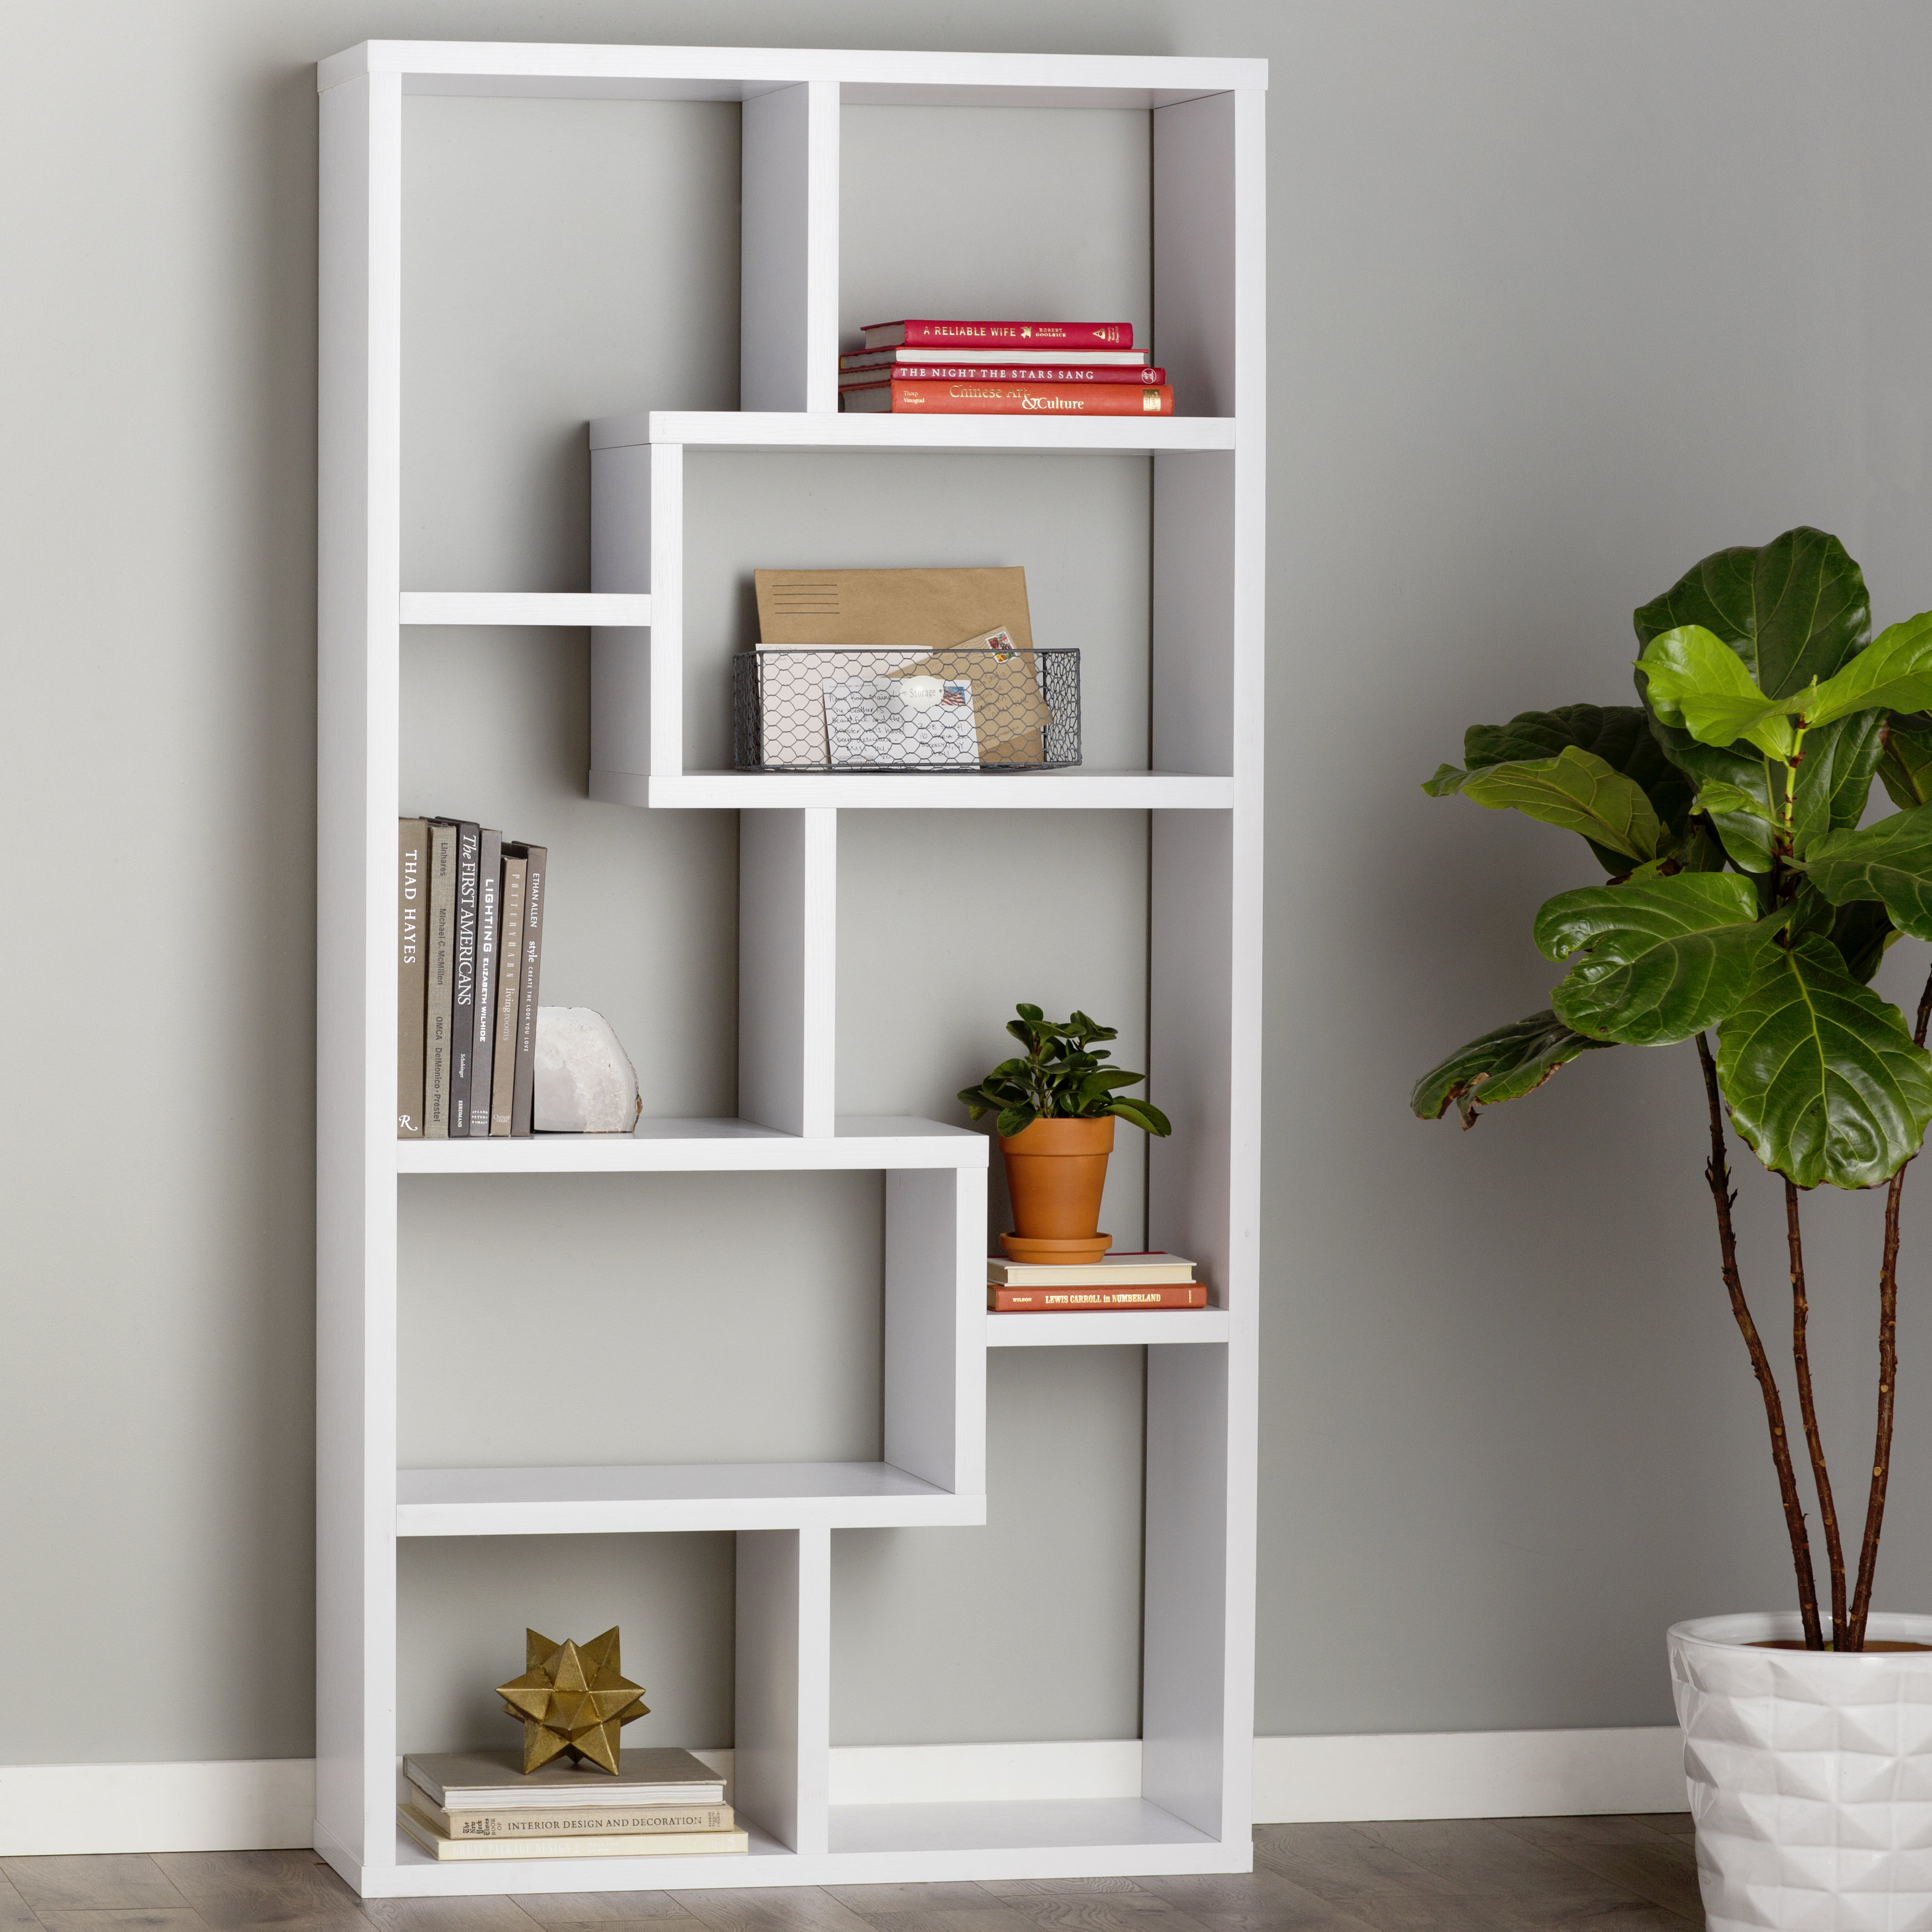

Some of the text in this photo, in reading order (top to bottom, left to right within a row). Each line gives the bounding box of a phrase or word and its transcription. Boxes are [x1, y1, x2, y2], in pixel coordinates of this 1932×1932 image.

[924, 326, 1017, 337] A RELIABLE WIFE
[900, 368, 1095, 379] THE NIGHT THE STARS SANG
[949, 385, 1029, 399] Chinese Art
[910, 688, 936, 699] Storage
[403, 850, 417, 964] THAD HAYES
[530, 873, 540, 928] ETHAN ALLEN
[457, 835, 477, 1005] The FIRST AMERICANS
[483, 879, 494, 952] LIGHTING
[528, 941, 538, 963] style
[481, 959, 489, 1004] ELIZABETH
[398, 1115, 418, 1132] R
[1045, 1294, 1161, 1304] LEWIS CARROLL in NUMBERLAND
[497, 1822, 502, 1831] OF
[508, 1816, 702, 1830] INTERIOR DESIGN AND DECORATION
[452, 1844, 485, 1857] GREAT
[488, 1843, 532, 1856] PACKAGE
[535, 1842, 571, 1854] DESIGN
